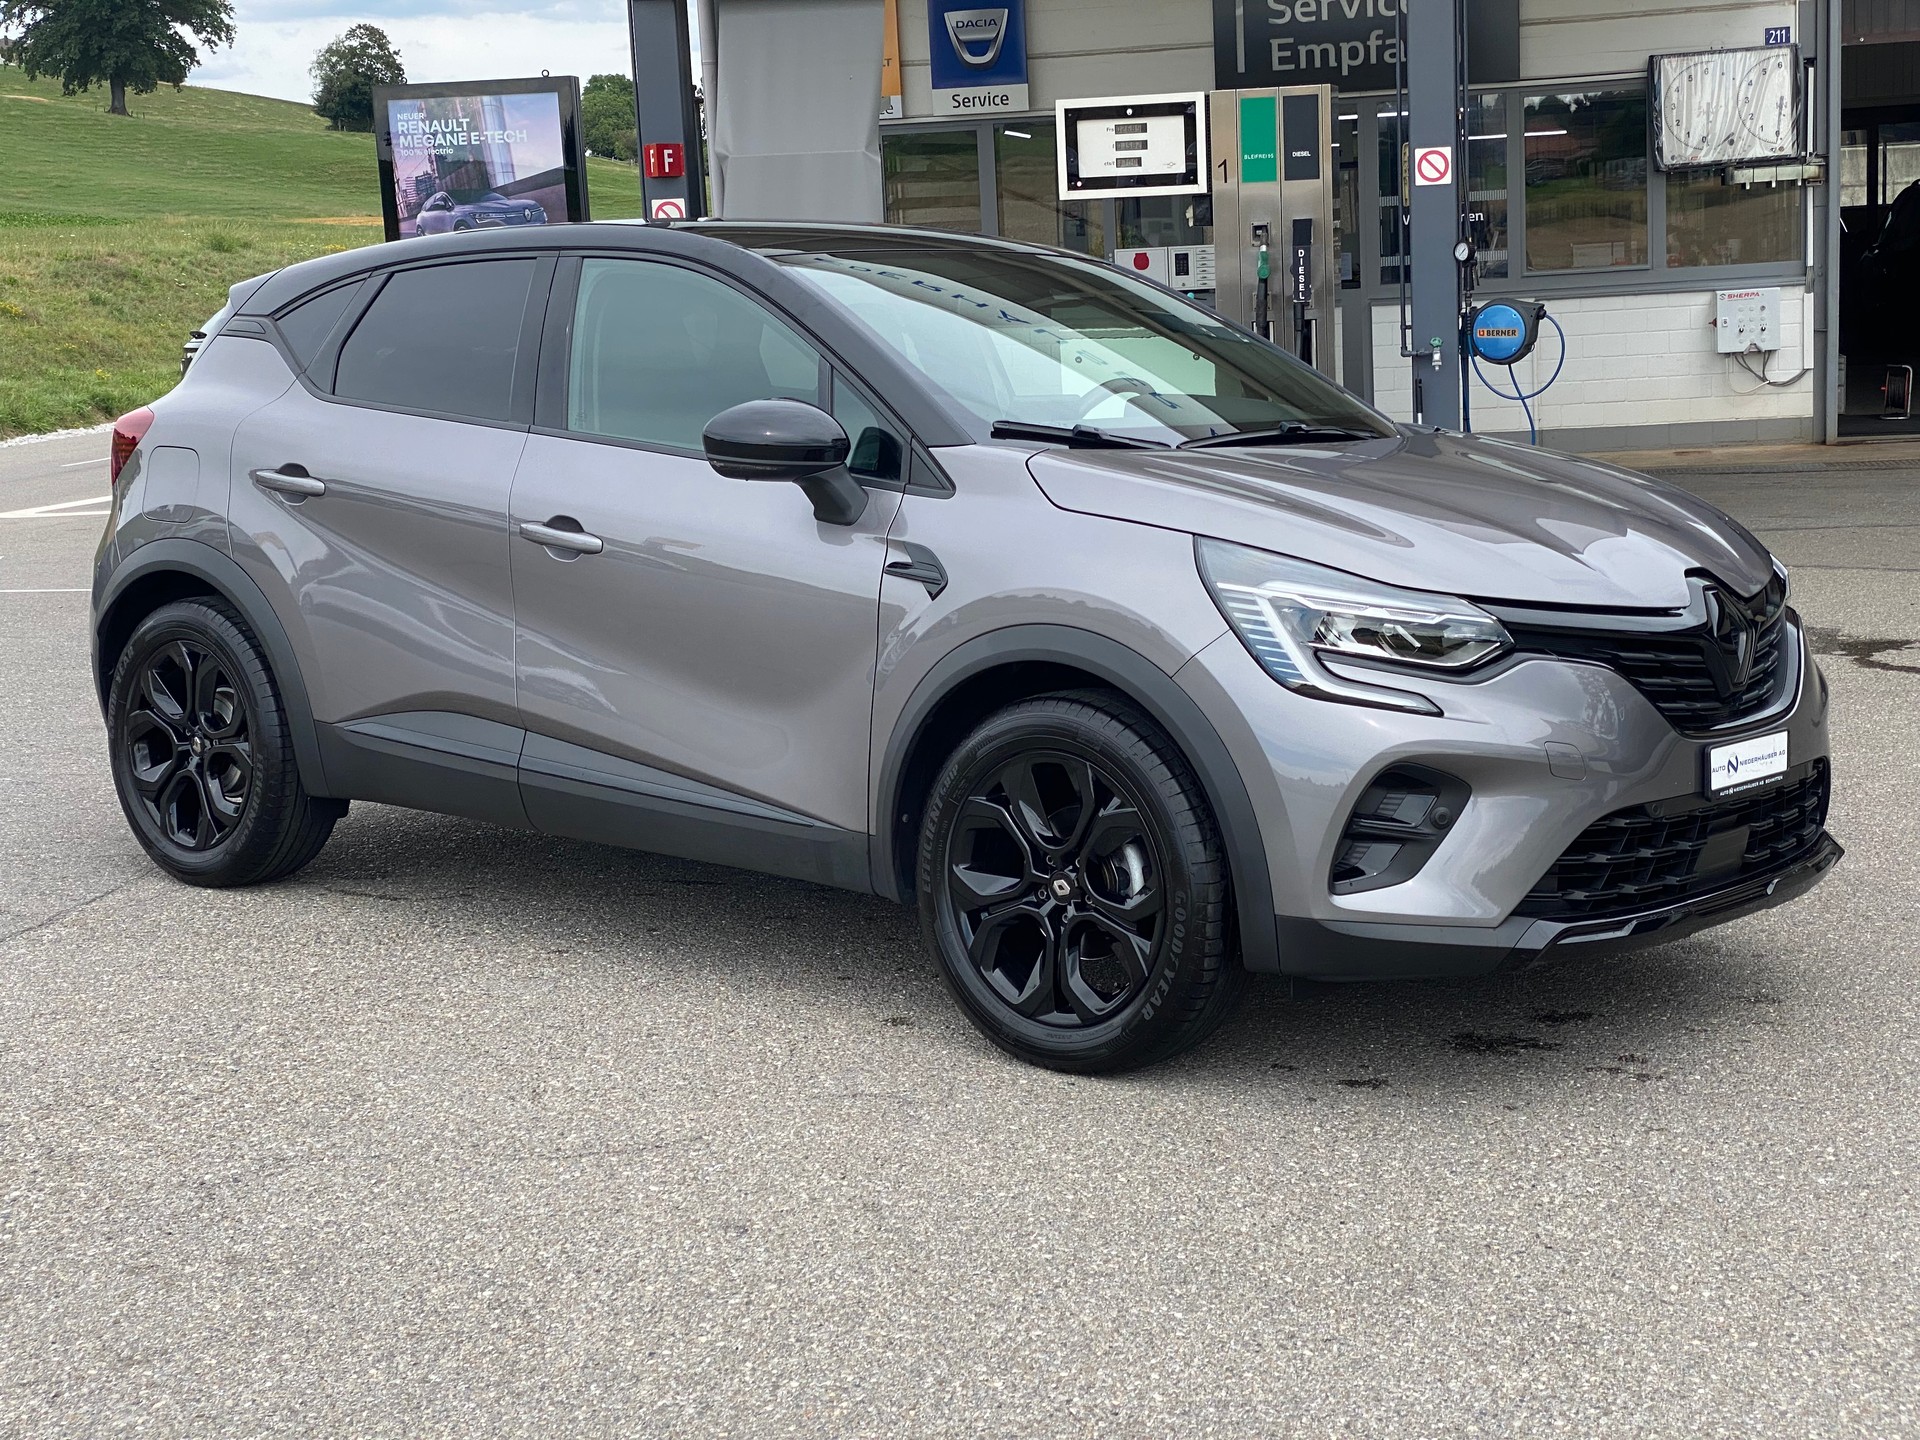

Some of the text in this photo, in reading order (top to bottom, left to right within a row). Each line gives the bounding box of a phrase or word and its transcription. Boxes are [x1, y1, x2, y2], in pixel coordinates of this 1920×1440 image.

[1268, 0, 1407, 24] Servic
[955, 18, 998, 29] DACIA
[1769, 29, 1786, 44] 211
[1269, 29, 1407, 76] Empfa
[951, 92, 1010, 109] Service
[397, 112, 424, 120] NEUER
[397, 118, 470, 133] RENAULT
[399, 129, 527, 149] MEGANE E-TECH
[423, 146, 454, 155] electric
[649, 149, 655, 173] F
[663, 149, 674, 173] F
[1217, 158, 1228, 184] 1
[1727, 291, 1760, 299] SHERPA
[1486, 329, 1517, 337] BERNER
[1712, 765, 1726, 773] AUTO
[1740, 751, 1777, 765] NIEDERHÄUSER
[1142, 889, 1187, 1021] GOODYEAR
